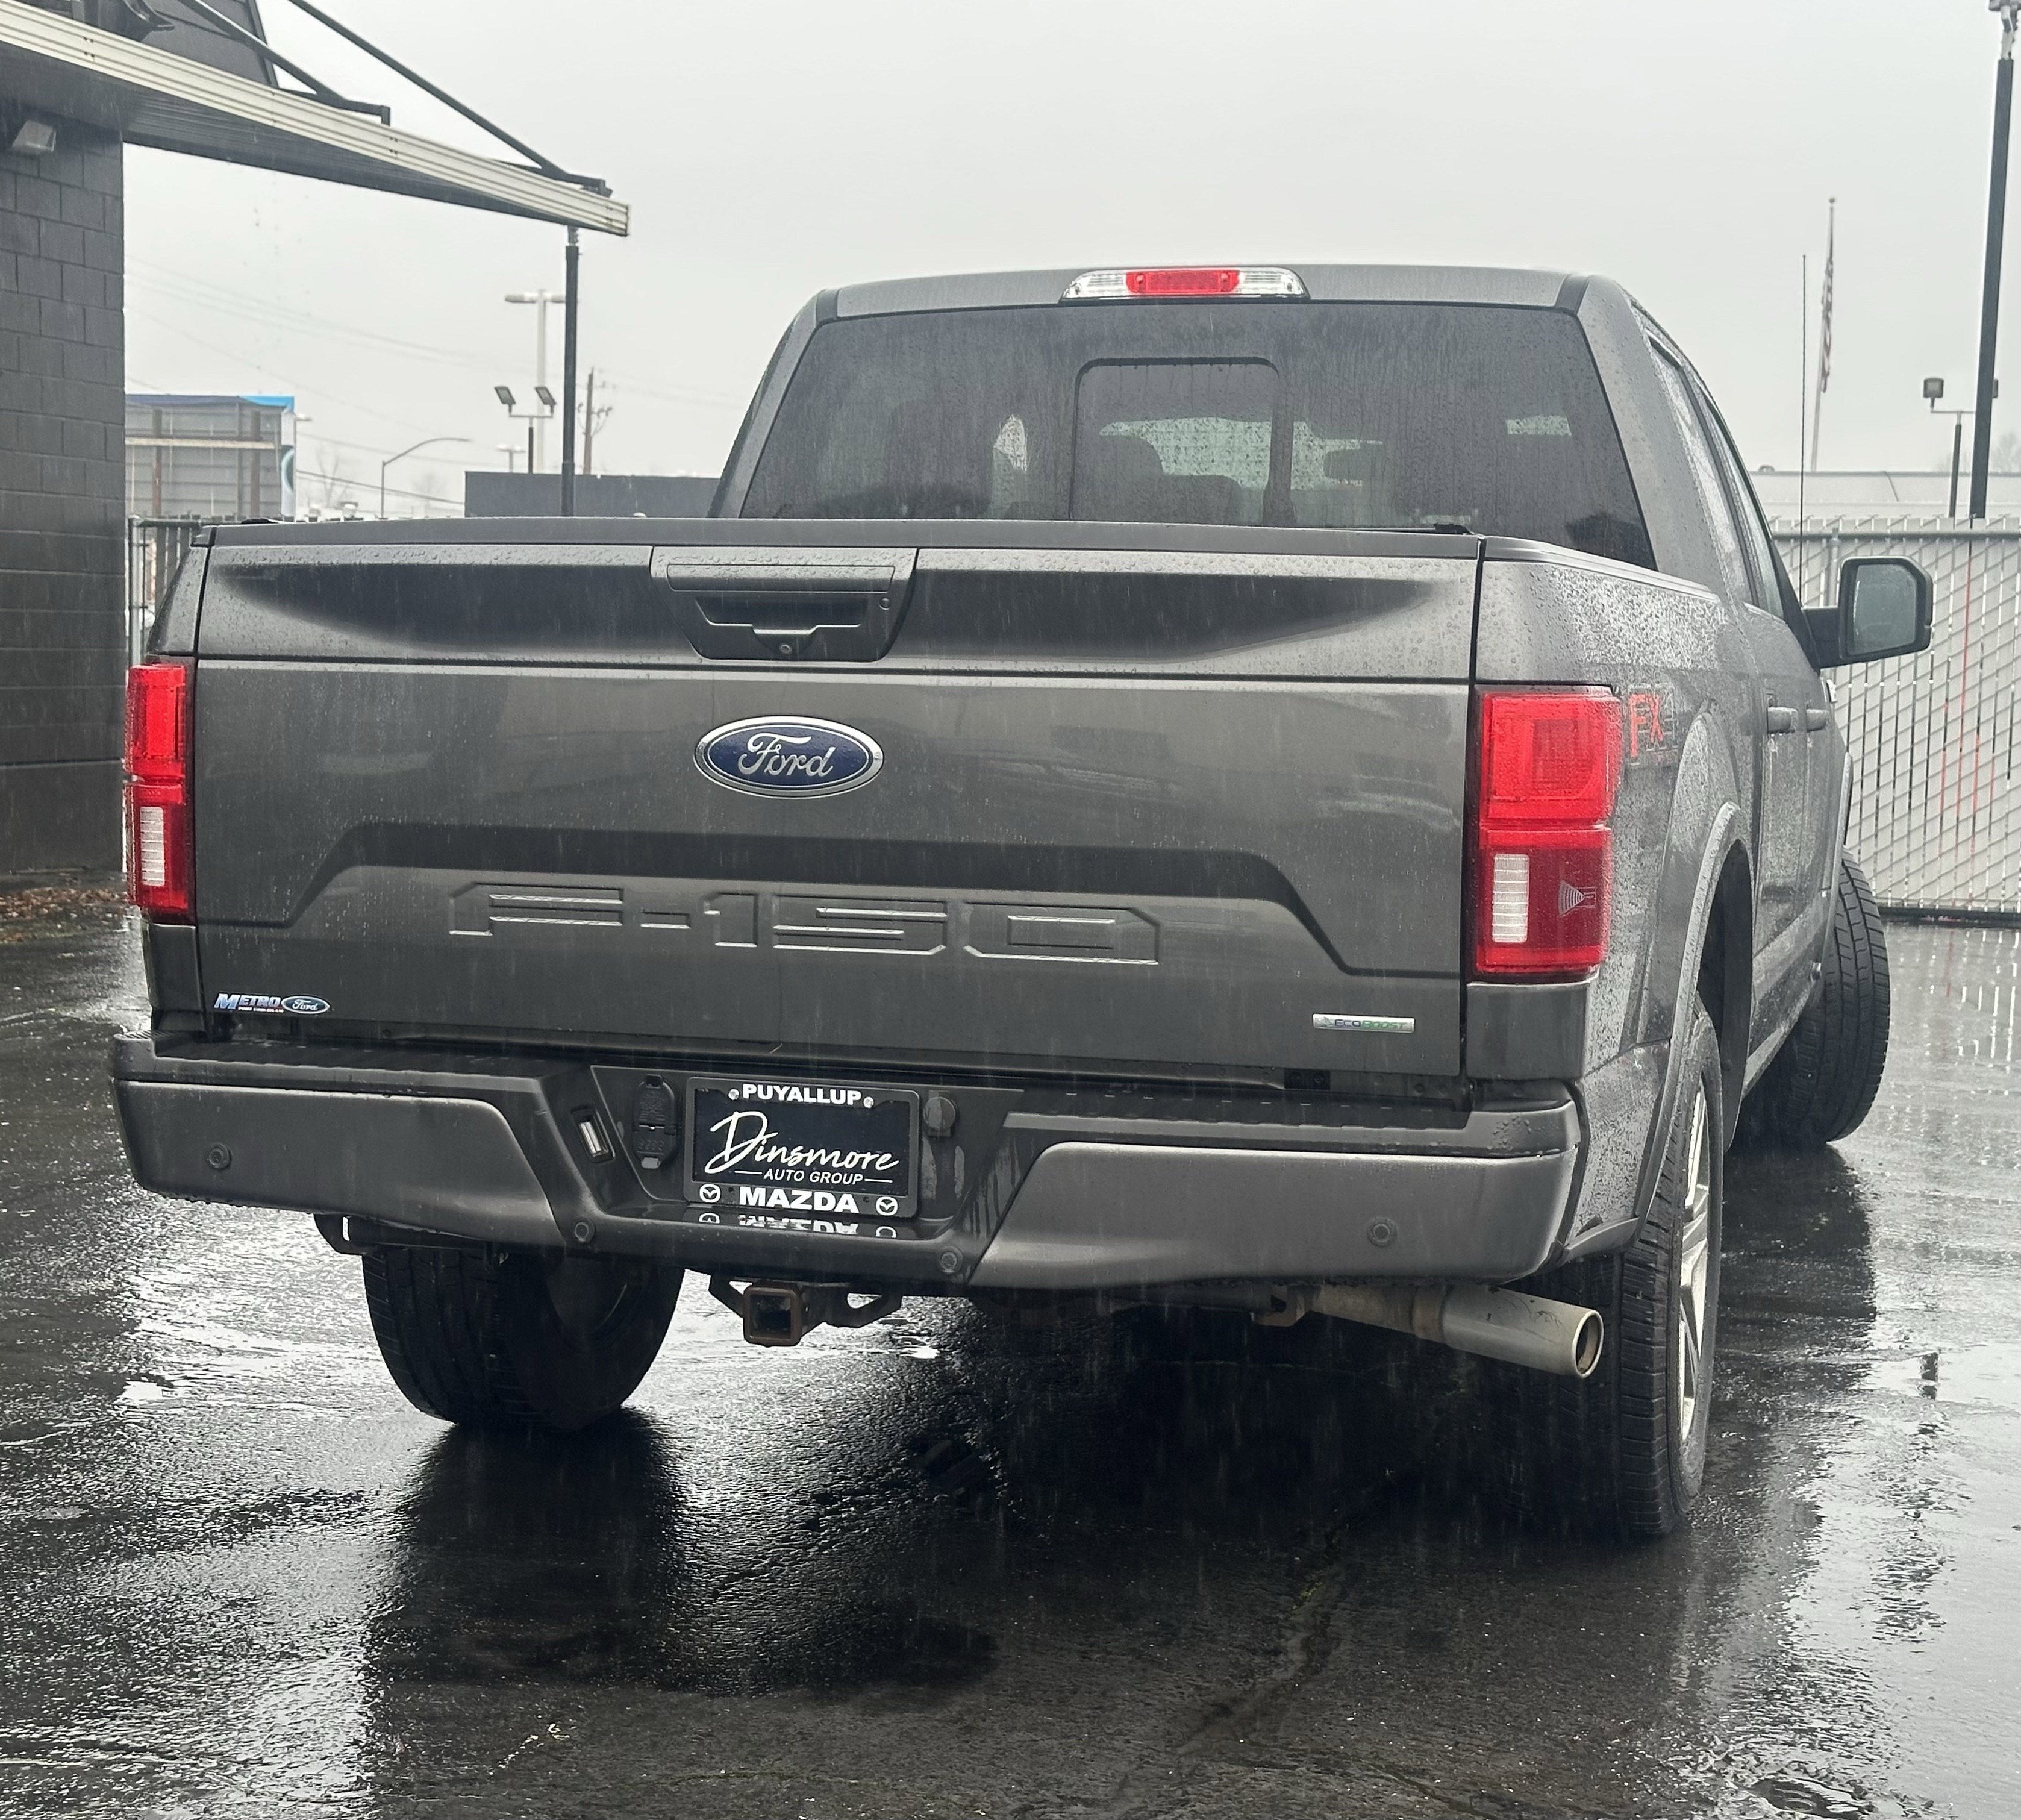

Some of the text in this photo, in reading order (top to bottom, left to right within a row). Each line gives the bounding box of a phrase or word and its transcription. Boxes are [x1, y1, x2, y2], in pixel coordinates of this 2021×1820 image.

[737, 732, 836, 777] Ford
[448, 881, 1159, 966] F-150
[214, 993, 281, 1009] METRO
[292, 999, 318, 1012] Ford
[1334, 1019, 1407, 1029] ECOBOOST
[742, 1084, 861, 1104] PUYALLUP
[704, 1110, 899, 1174] Dinsmore
[763, 1168, 863, 1186] AUTO GROUP
[739, 1185, 860, 1213] MAZDA
